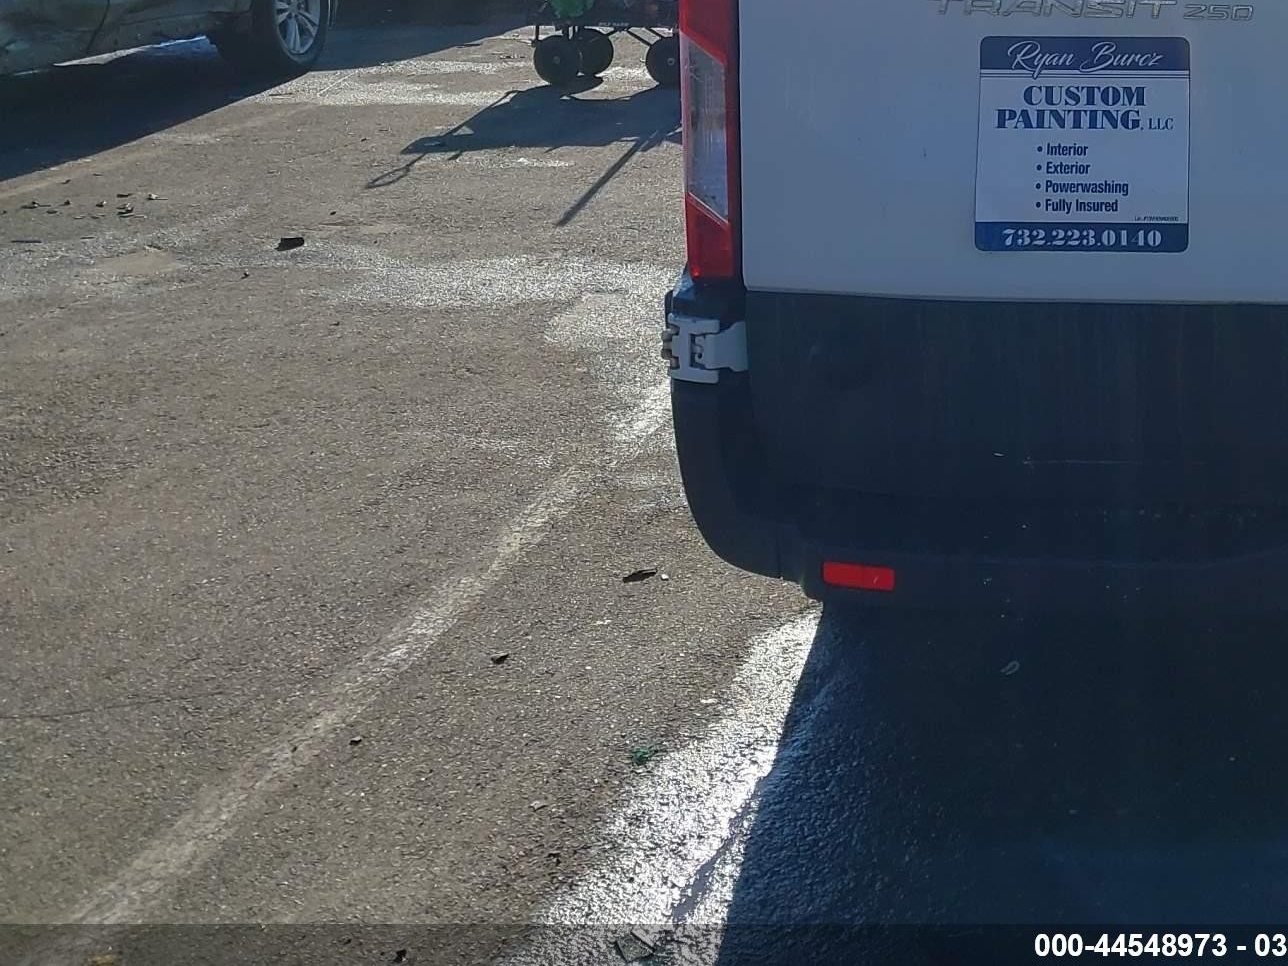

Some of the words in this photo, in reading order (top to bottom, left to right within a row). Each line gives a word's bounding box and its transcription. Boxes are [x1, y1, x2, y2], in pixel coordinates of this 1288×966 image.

[1183, 3, 1254, 21] 250
[1007, 40, 1074, 80] Ryan
[1079, 41, 1163, 73] Burcz
[1023, 85, 1146, 106] CUSTOM
[1148, 118, 1174, 130] LLC
[1046, 142, 1088, 156] Interior
[1046, 161, 1091, 174] Exterior
[1045, 180, 1129, 196] Powerwashing
[1045, 199, 1072, 214] Fully
[1075, 199, 1118, 212] Insured
[1003, 228, 1162, 247] 732.223.0140
